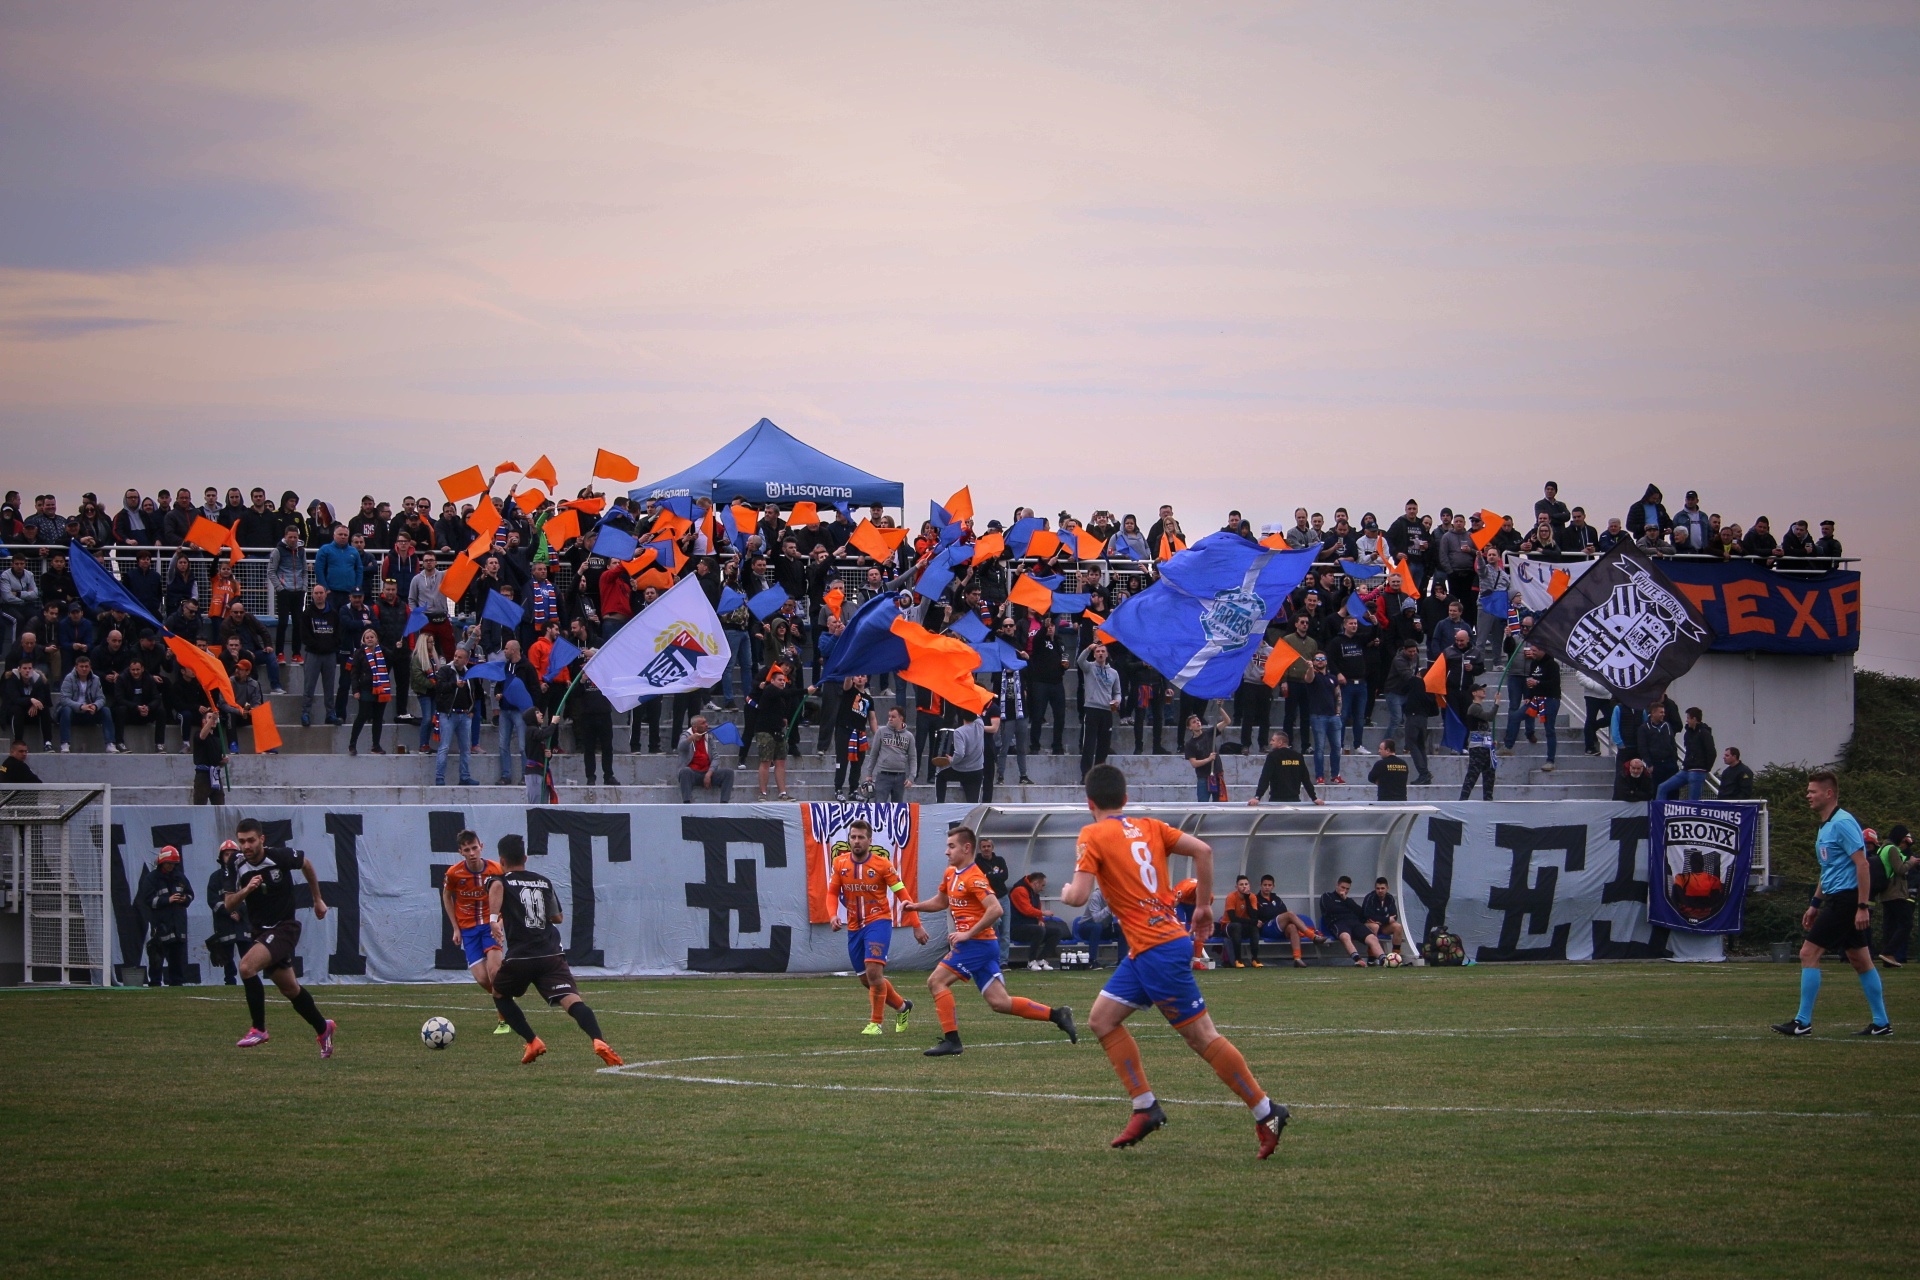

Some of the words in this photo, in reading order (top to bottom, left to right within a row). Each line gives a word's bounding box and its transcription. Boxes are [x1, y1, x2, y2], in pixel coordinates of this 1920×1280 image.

[782, 483, 853, 498] Husqvarna
[1634, 574, 1661, 599] WHITE
[1657, 593, 1686, 621] STONES
[1214, 601, 1252, 636] VARTEKS
[1664, 804, 1698, 817] WHITE
[1700, 808, 1742, 825] STONES
[1669, 823, 1735, 847] BRONX
[1131, 841, 1158, 893] 8
[519, 887, 546, 930] 11
